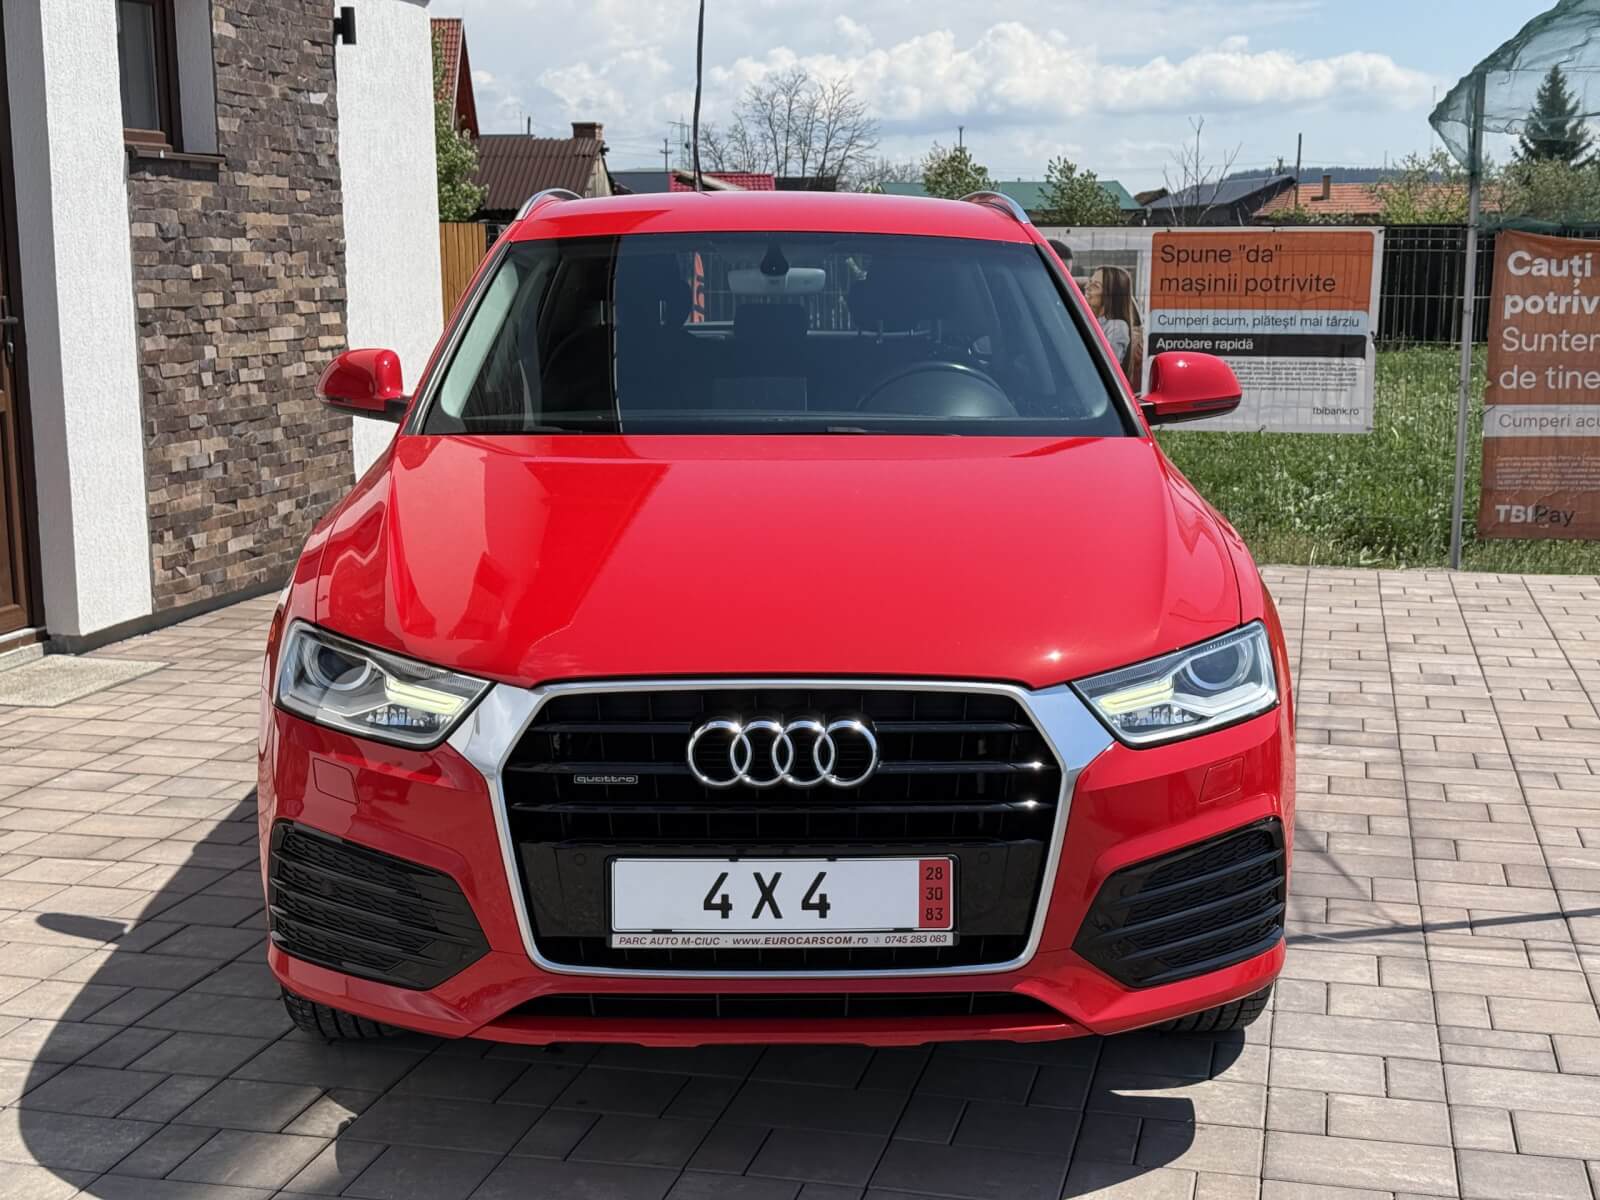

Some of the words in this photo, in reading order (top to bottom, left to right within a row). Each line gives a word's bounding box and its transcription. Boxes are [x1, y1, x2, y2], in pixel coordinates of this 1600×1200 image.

[1160, 244, 1232, 266] Spune
[1238, 245, 1282, 263] "da"
[1507, 250, 1592, 286] Cauți
[1160, 274, 1237, 296] mașinii
[1245, 274, 1336, 296] potrivite
[1158, 314, 1209, 330] Cumperi
[1212, 317, 1249, 328] acum,
[1300, 316, 1323, 328] mai
[1326, 316, 1360, 328] târziu
[1156, 337, 1212, 350] Aprobare
[1215, 338, 1254, 351] rapidă
[1499, 364, 1537, 390] de
[1545, 365, 1600, 390] tine
[1499, 414, 1571, 430] Cumperi
[576, 775, 636, 784] quattro
[925, 867, 943, 881] 28
[703, 872, 733, 919] 4
[751, 872, 783, 919] X
[801, 871, 831, 919] 4
[925, 887, 943, 901] 30
[925, 907, 943, 921] 83
[619, 936, 647, 945] PARC
[650, 936, 679, 945] AUTO
[681, 936, 721, 945] M-CIUC
[884, 935, 908, 944] 0745
[910, 934, 928, 943] 283
[929, 934, 947, 943] 083
